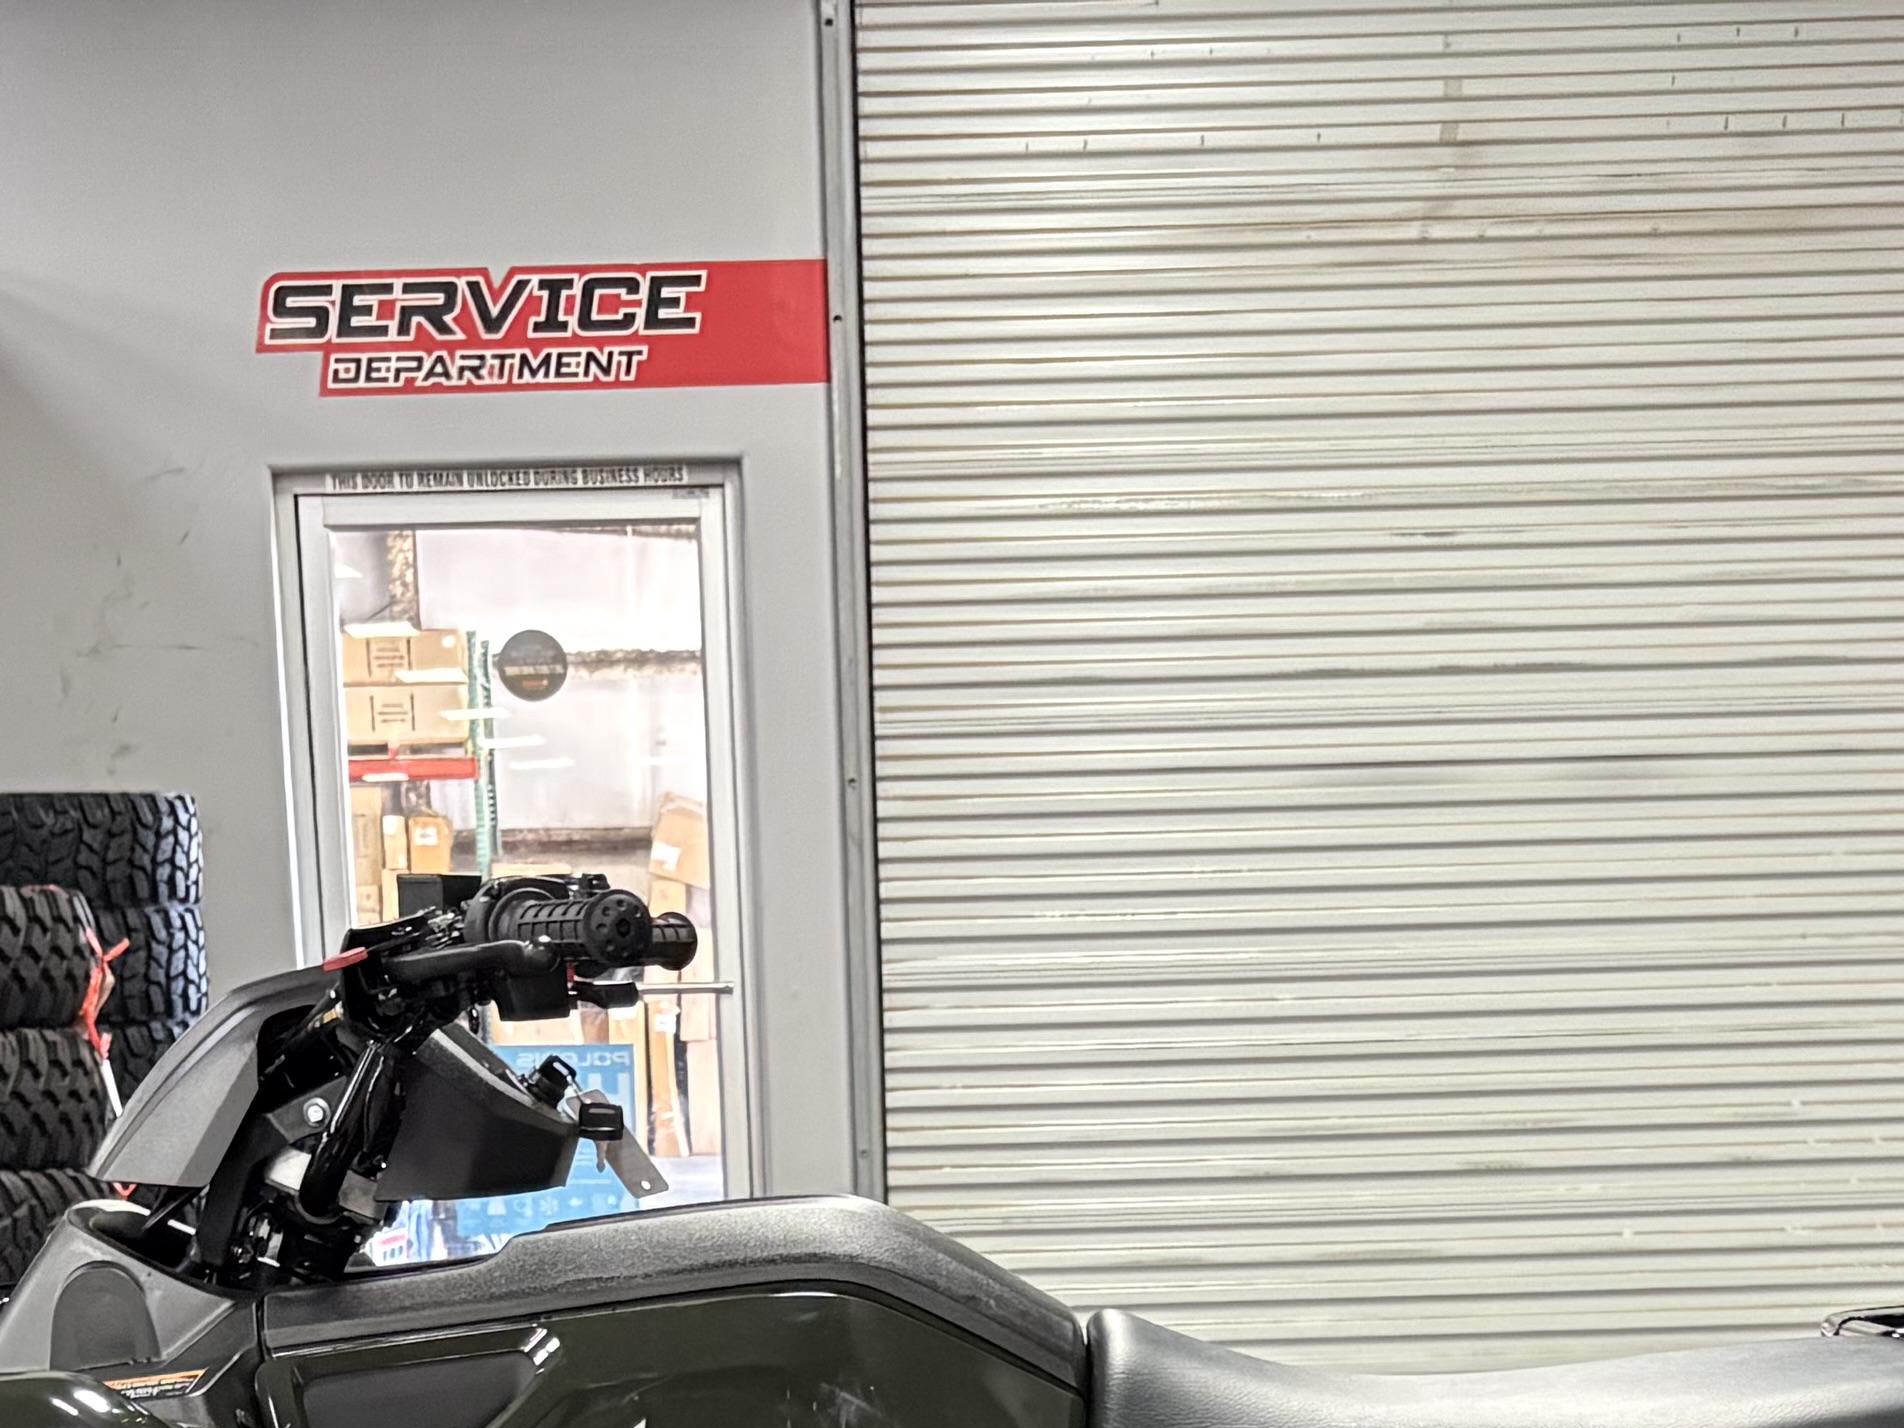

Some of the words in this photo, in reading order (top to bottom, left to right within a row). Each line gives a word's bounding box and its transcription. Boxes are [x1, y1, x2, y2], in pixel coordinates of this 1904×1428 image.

[264, 272, 706, 343] SERVICE
[331, 347, 645, 387] DEPARTMENT
[331, 475, 358, 491] THIS
[399, 473, 414, 489] TO
[418, 471, 464, 488] REMAIN
[467, 469, 530, 487] UNLOCKED
[533, 468, 578, 486] DURING
[581, 467, 640, 485] BUSINESS
[644, 465, 684, 482] HOURS
